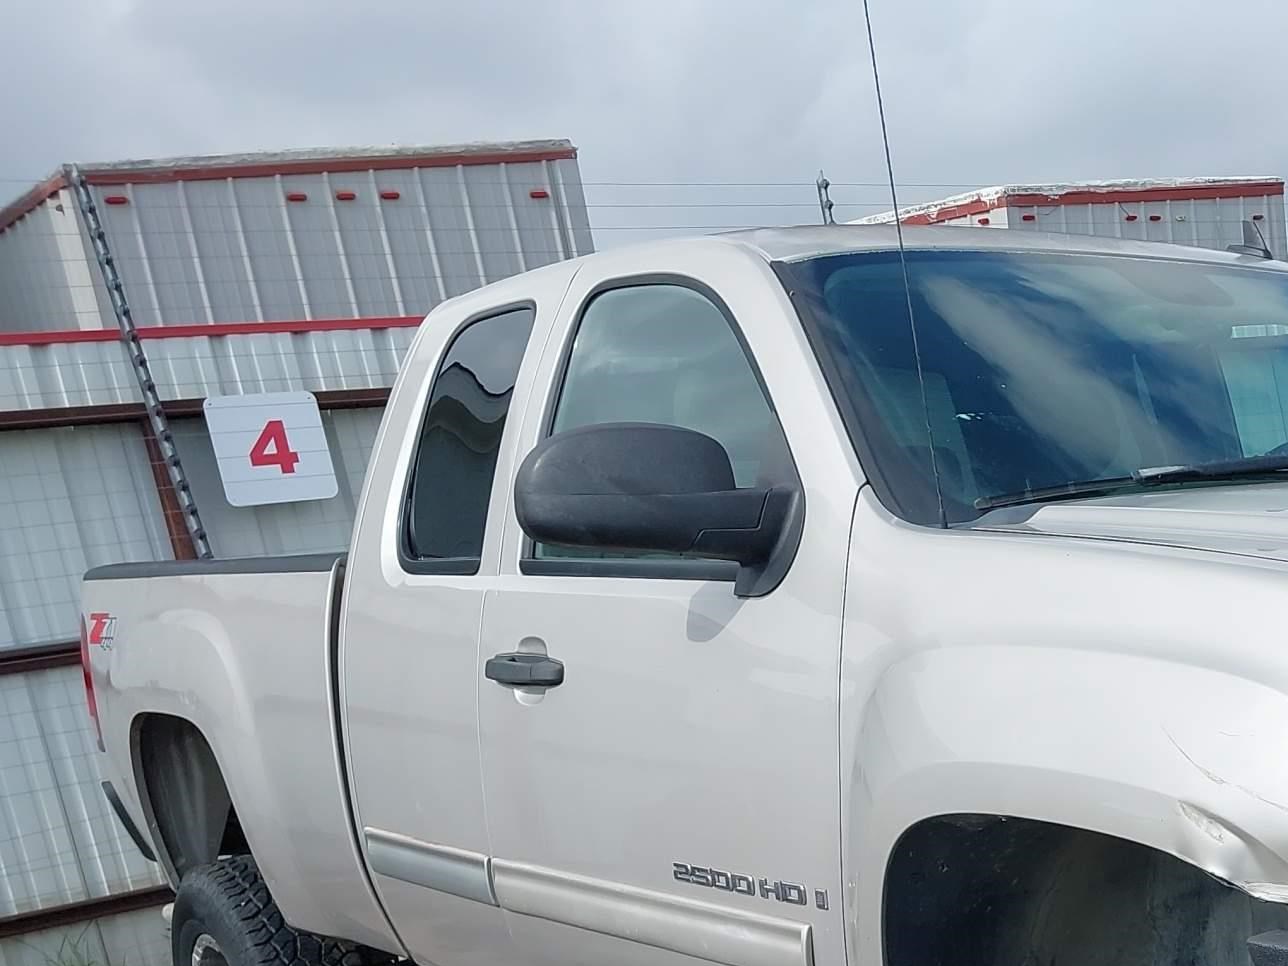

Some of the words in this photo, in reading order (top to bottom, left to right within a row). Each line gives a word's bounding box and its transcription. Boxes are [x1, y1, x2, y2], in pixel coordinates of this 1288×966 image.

[250, 420, 299, 474] 4
[672, 861, 756, 896] 2500
[758, 877, 808, 906] HD
